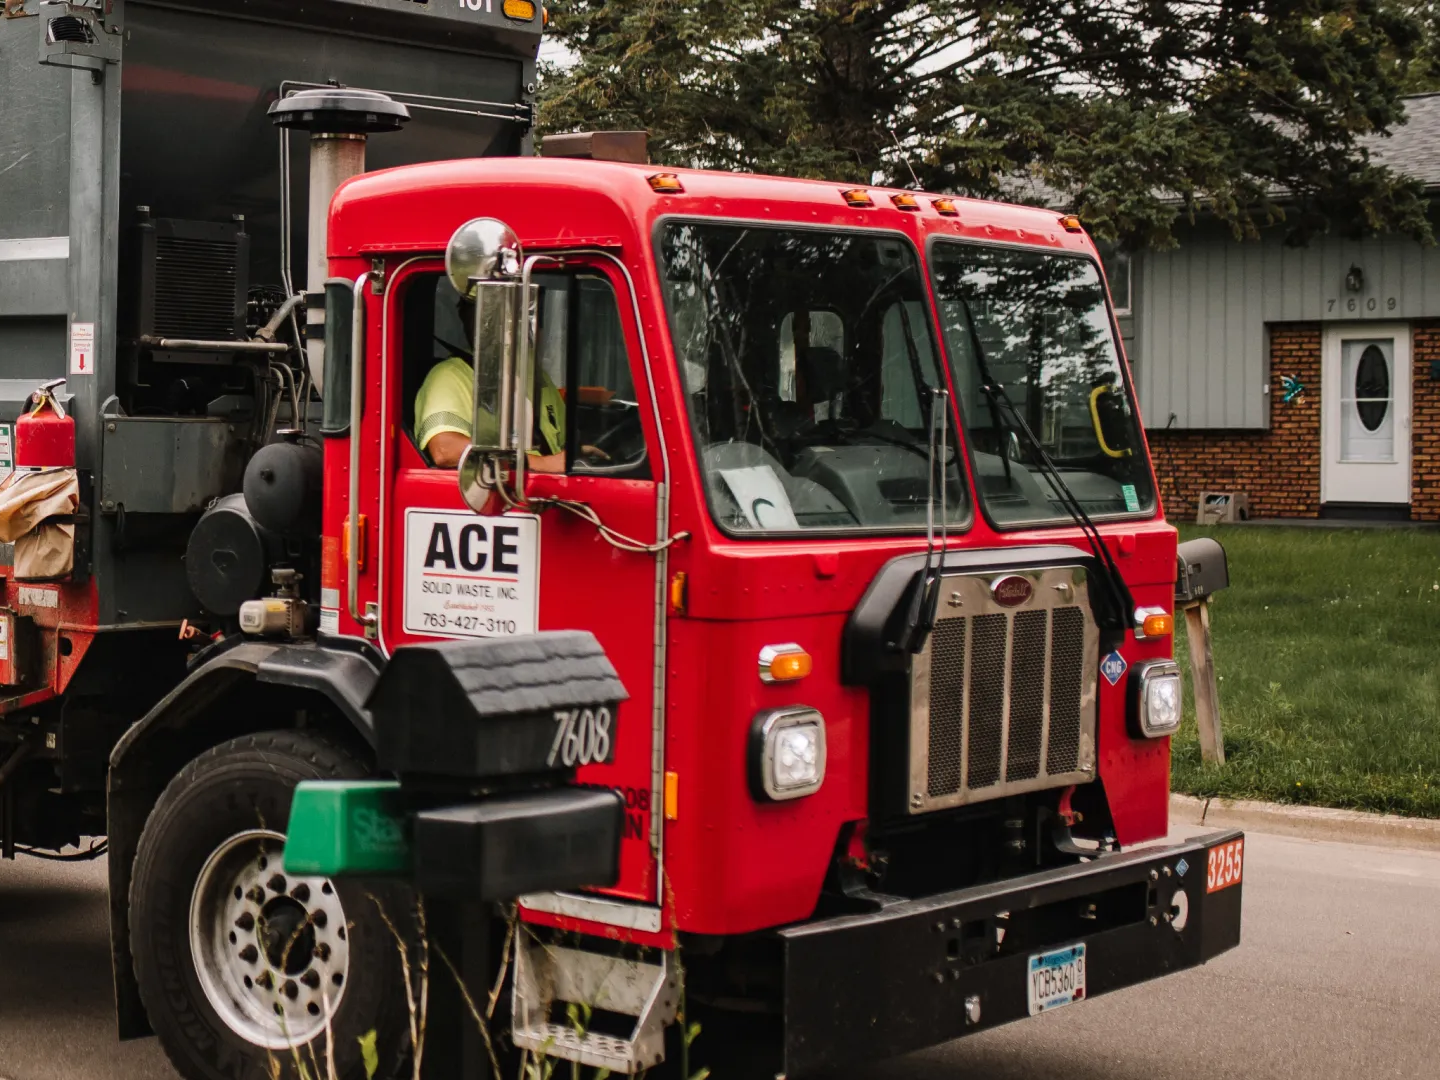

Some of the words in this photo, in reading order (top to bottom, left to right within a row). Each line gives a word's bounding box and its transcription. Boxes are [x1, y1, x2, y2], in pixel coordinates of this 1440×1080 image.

[1327, 297, 1397, 313] 7609
[423, 522, 519, 574] ACE
[422, 580, 453, 595] SOLID
[456, 583, 494, 600] WASTE,
[497, 586, 519, 600] INC.
[422, 613, 516, 634] 763-427-3110
[1106, 661, 1122, 674] CNG
[546, 707, 610, 767] 7608
[1208, 843, 1242, 889] 3255
[1033, 962, 1075, 1002] YCB5360
